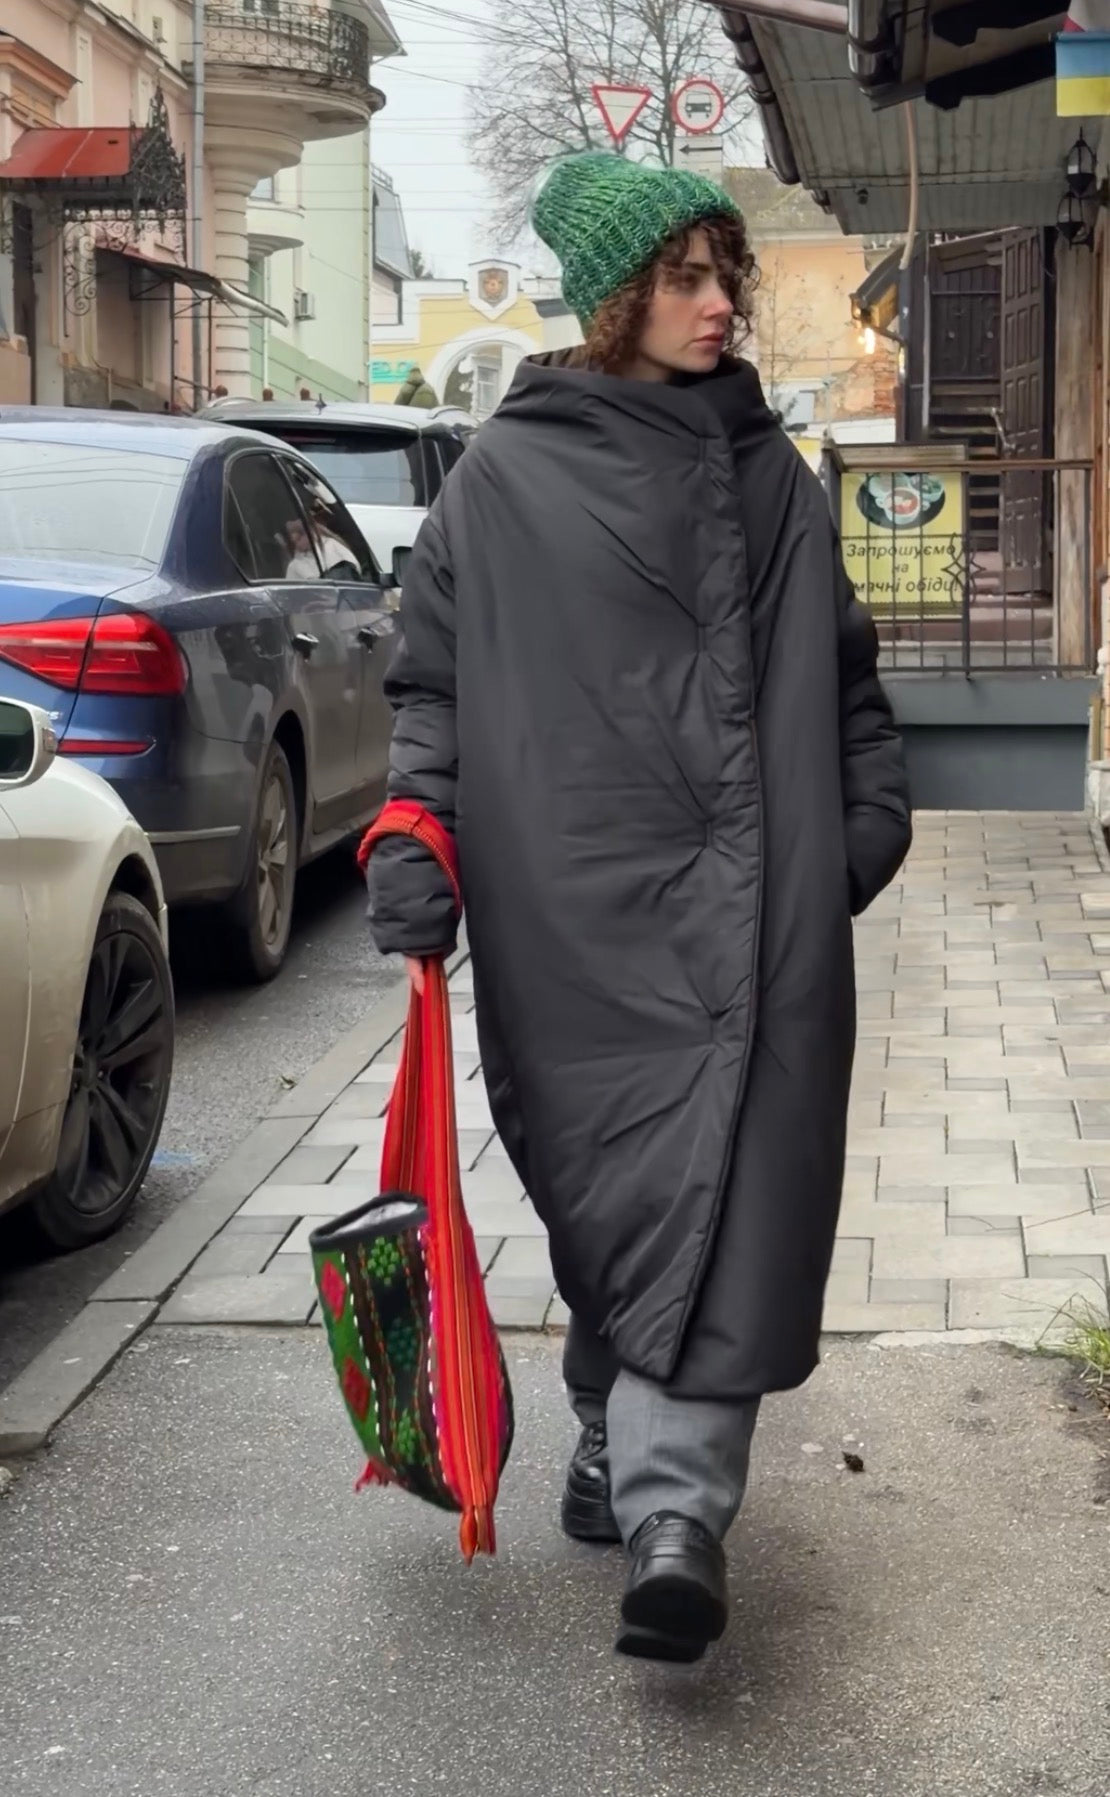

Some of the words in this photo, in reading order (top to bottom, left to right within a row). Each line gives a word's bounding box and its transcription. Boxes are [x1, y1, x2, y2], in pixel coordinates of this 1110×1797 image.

[846, 544, 956, 559] Запрошуємо
[892, 563, 909, 573] на
[853, 578, 900, 592] мачні
